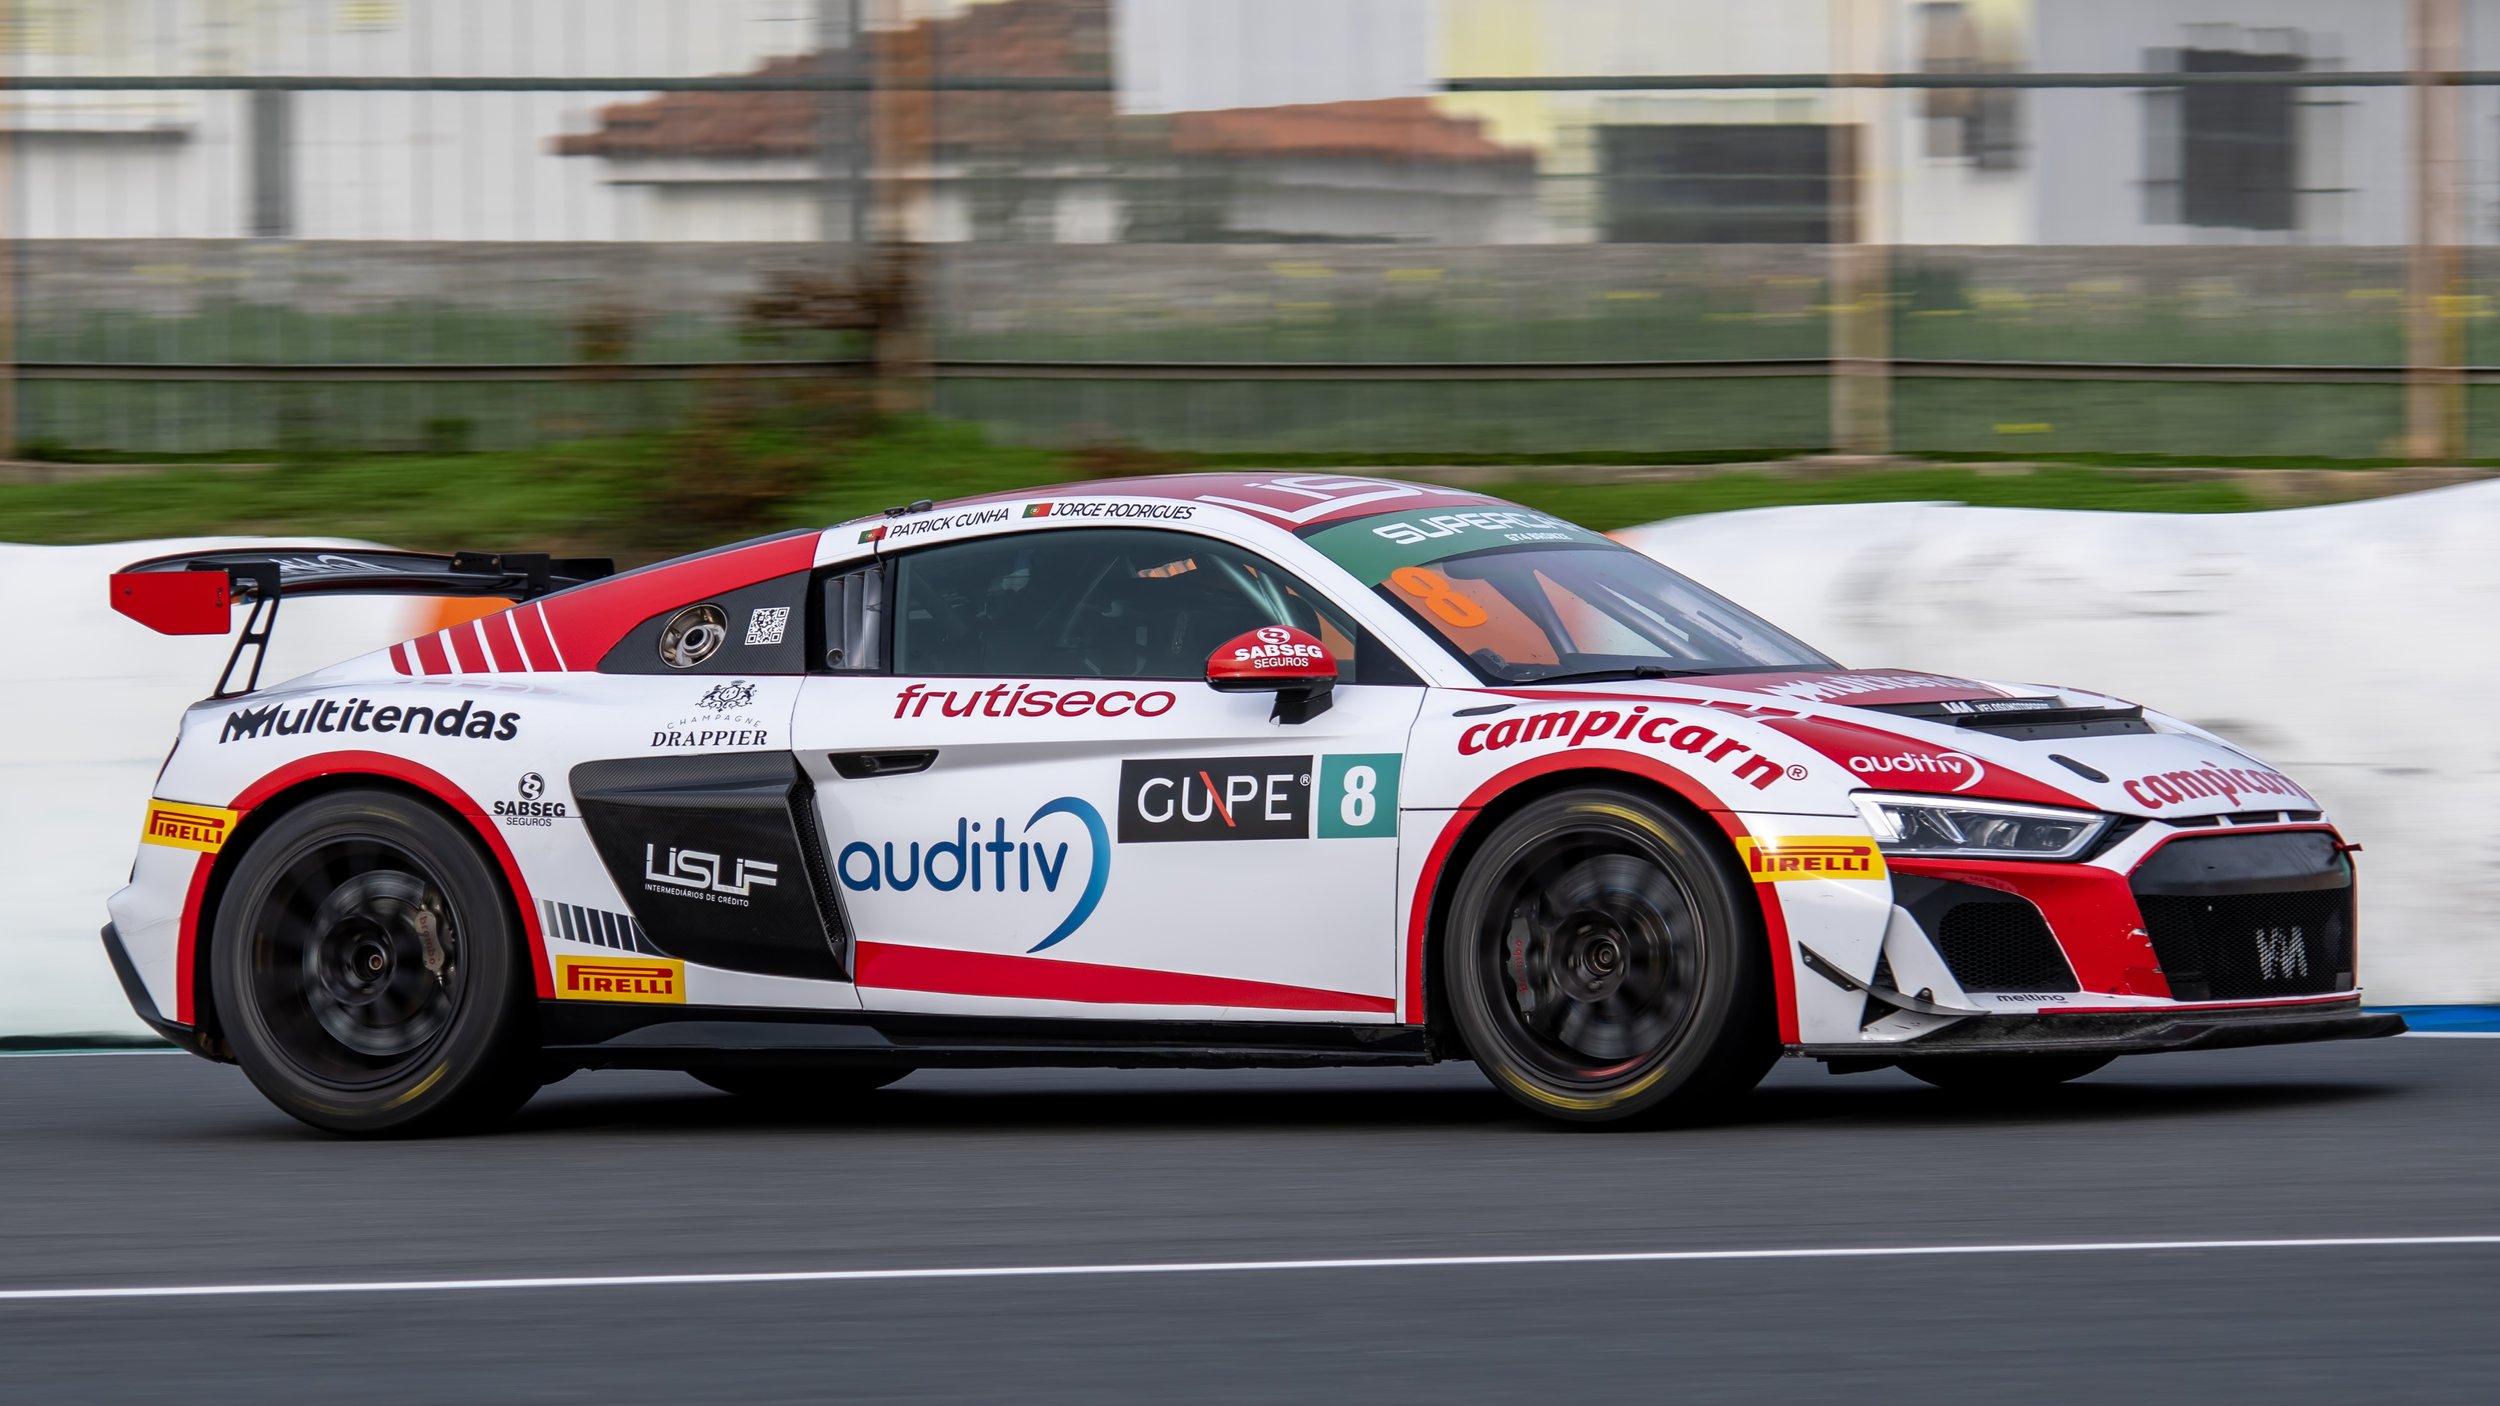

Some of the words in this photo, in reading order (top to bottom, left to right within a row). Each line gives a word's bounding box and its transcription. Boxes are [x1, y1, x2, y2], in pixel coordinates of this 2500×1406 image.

[889, 517, 952, 538] PATRICK
[955, 508, 1010, 527] CUNHA
[1050, 503, 1101, 516] JORGE
[1104, 503, 1196, 519] RODRIGUES
[1391, 567, 1488, 628] 8
[1234, 644, 1323, 661] SABSEG
[1254, 657, 1309, 668] SEGUROS
[893, 683, 1177, 719] frutiseco
[218, 697, 521, 744] Multitendas
[666, 713, 761, 730] CHAMPAGNE
[651, 730, 768, 747] DRAPPIER
[1850, 752, 1975, 778] auditiv
[1340, 765, 1377, 827] 8
[2123, 760, 2315, 810] campicarn
[493, 800, 566, 817] SABSEG
[506, 816, 552, 827] SEGUROS
[149, 809, 226, 845] PIRELLI
[838, 796, 1090, 895] auditiv
[1750, 846, 1871, 872] PIRELLI
[644, 883, 704, 900] INTERMEDIÁRIOS
[705, 893, 716, 902] DE
[717, 894, 749, 907] CRÉDITO
[567, 964, 673, 994] PIRELLI
